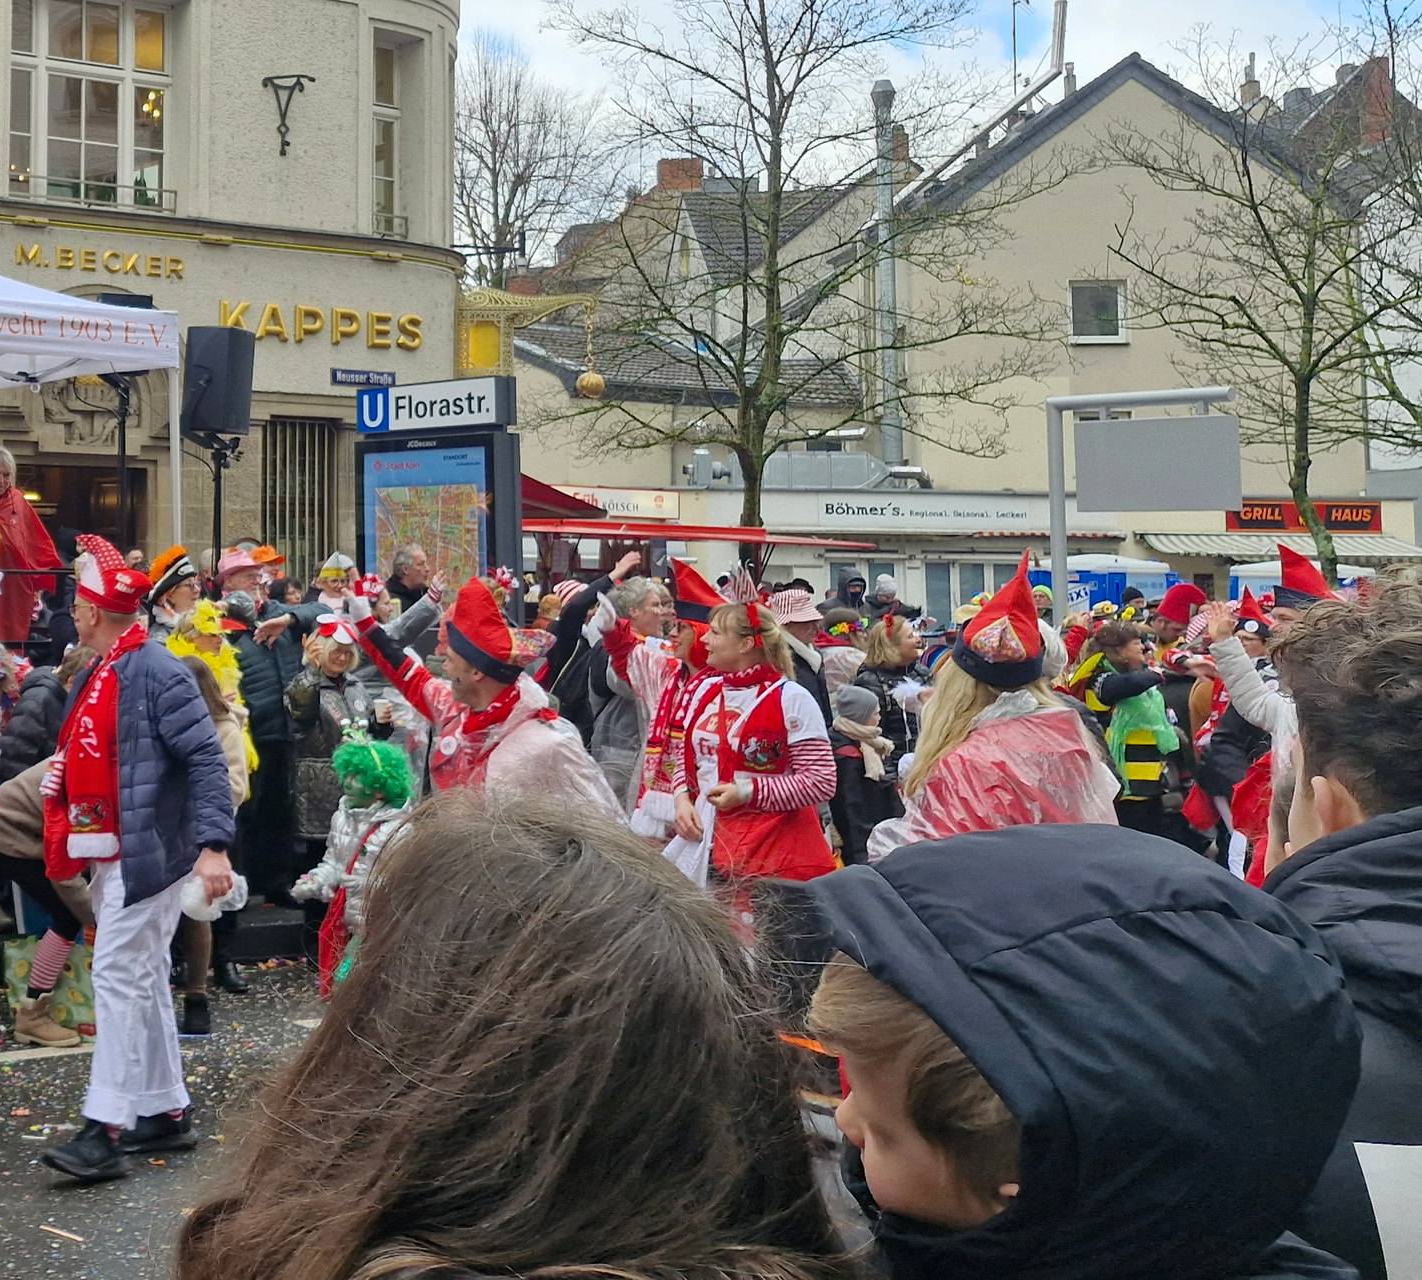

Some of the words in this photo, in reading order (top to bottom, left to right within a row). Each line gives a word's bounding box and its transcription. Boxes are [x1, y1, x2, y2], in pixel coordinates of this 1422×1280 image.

[59, 315, 112, 342] 1903
[123, 320, 170, 349] E.V.
[219, 300, 424, 350] KAPPES
[336, 371, 367, 382] Neusser
[369, 372, 393, 385] Straße
[363, 393, 383, 428] U
[394, 392, 490, 420] Florastr.
[407, 440, 437, 448] JCDecaux
[1240, 507, 1282, 521] GRILL
[1331, 508, 1372, 521] HAUS
